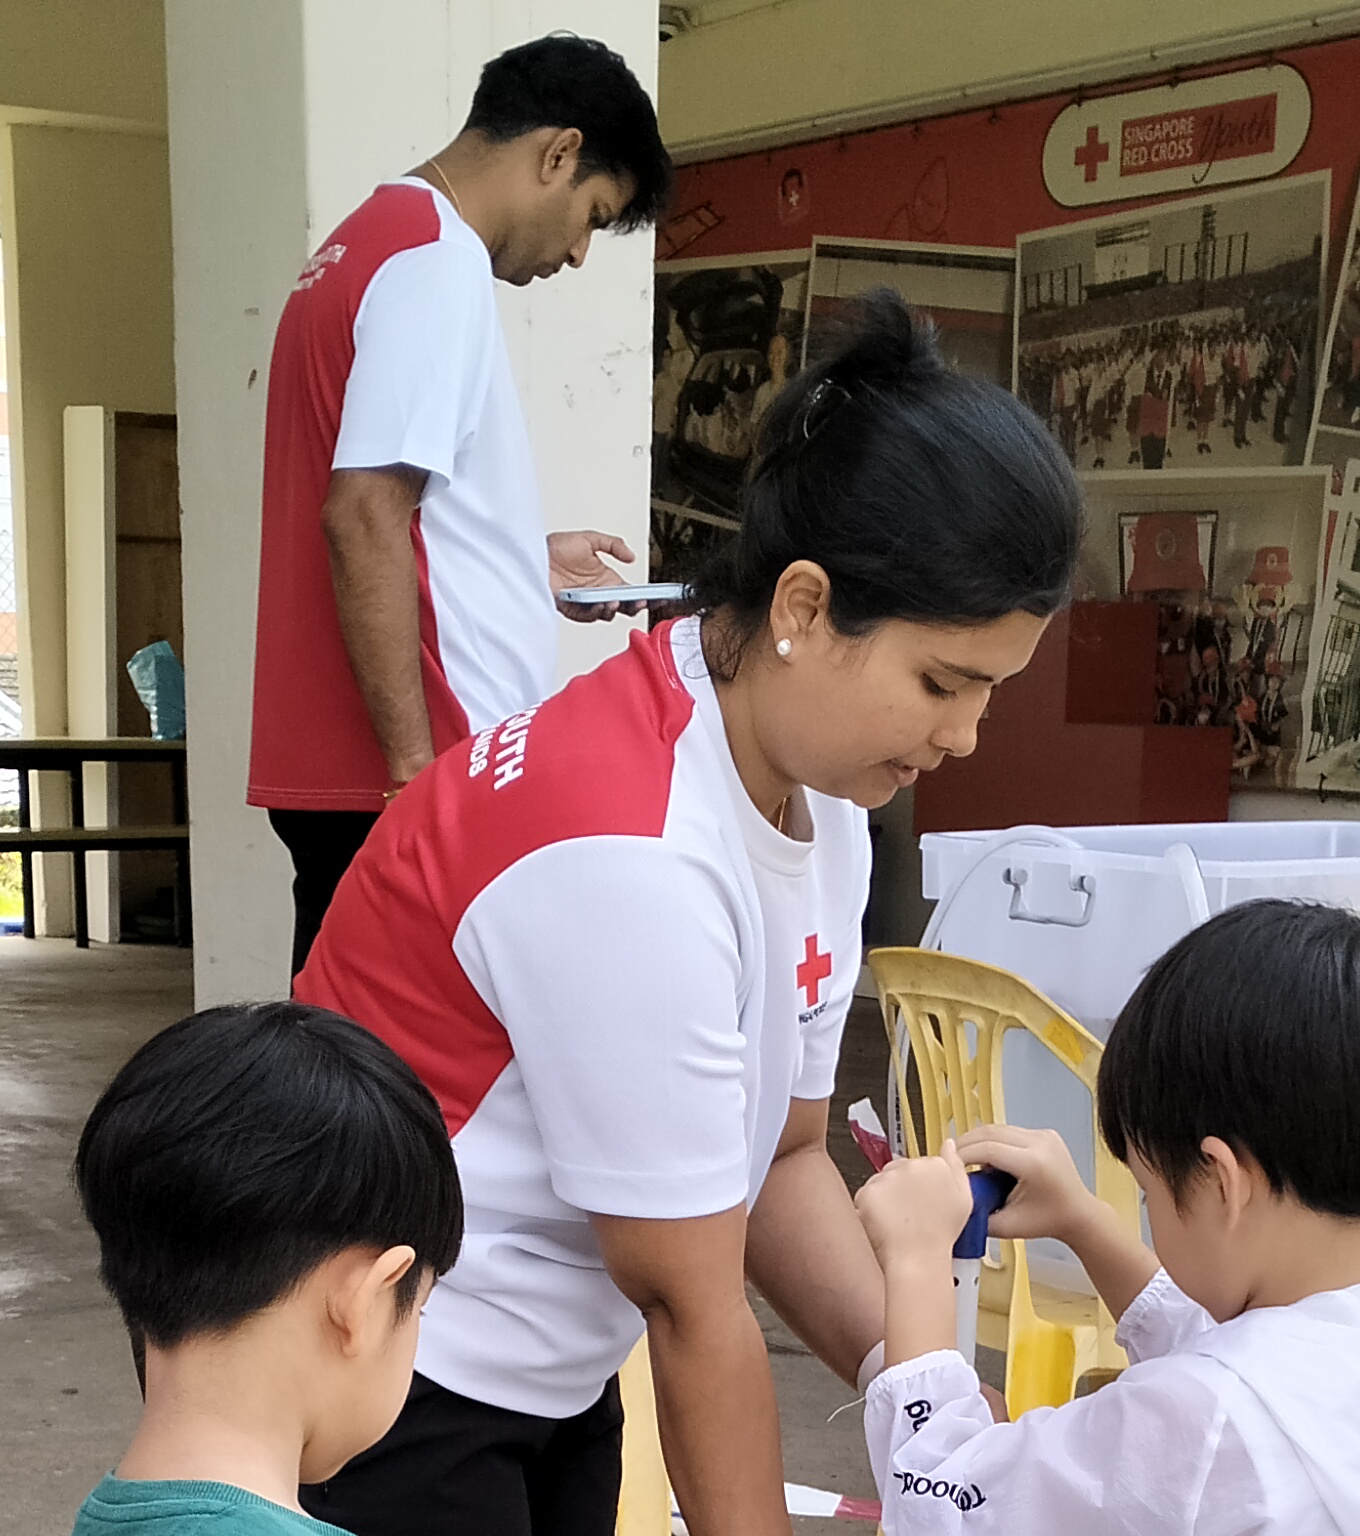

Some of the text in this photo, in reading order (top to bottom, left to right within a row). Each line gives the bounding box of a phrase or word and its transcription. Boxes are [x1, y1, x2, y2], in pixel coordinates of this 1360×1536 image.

[1124, 116, 1196, 146] SINGAPORE
[1122, 138, 1194, 166] RED CROSS
[493, 703, 543, 791] OUTH
